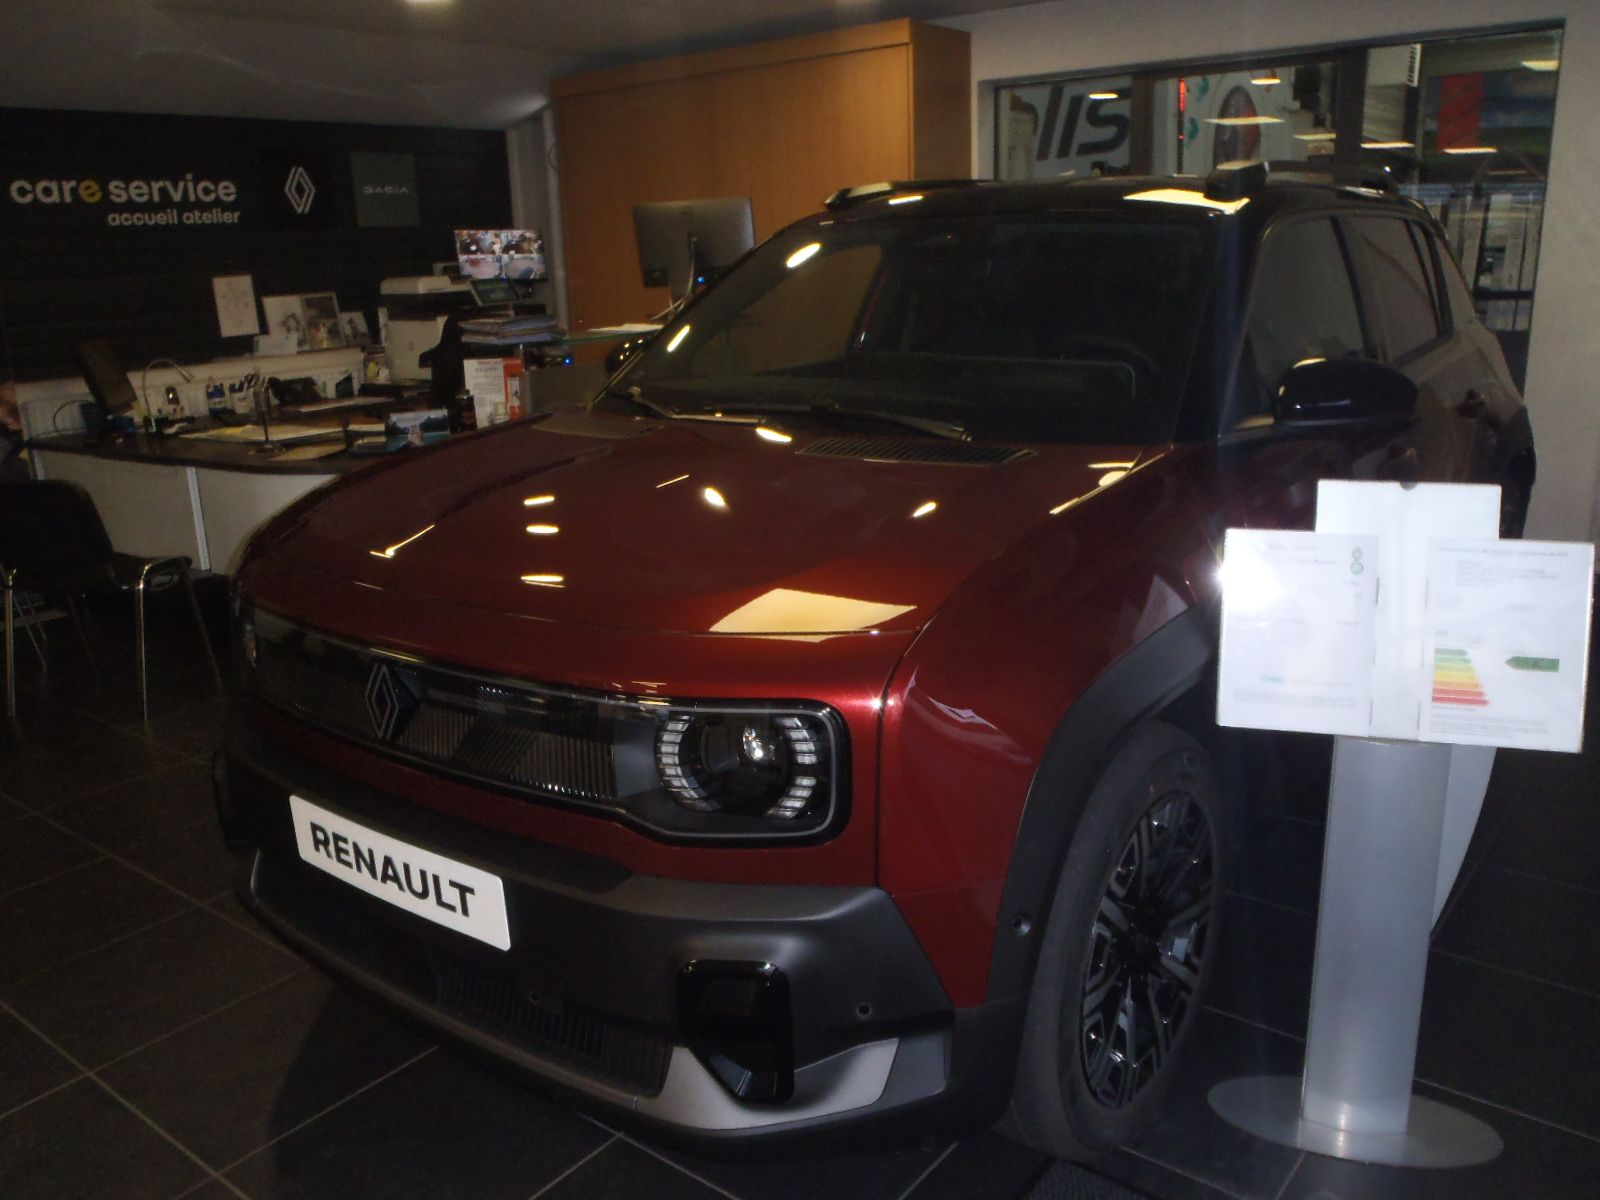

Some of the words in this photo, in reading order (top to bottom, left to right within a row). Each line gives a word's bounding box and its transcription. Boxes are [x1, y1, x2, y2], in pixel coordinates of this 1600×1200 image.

[9, 180, 101, 204] care
[108, 173, 236, 204] service
[107, 210, 177, 226] accueil
[183, 208, 240, 225] atelier
[310, 821, 476, 918] RENAULT
